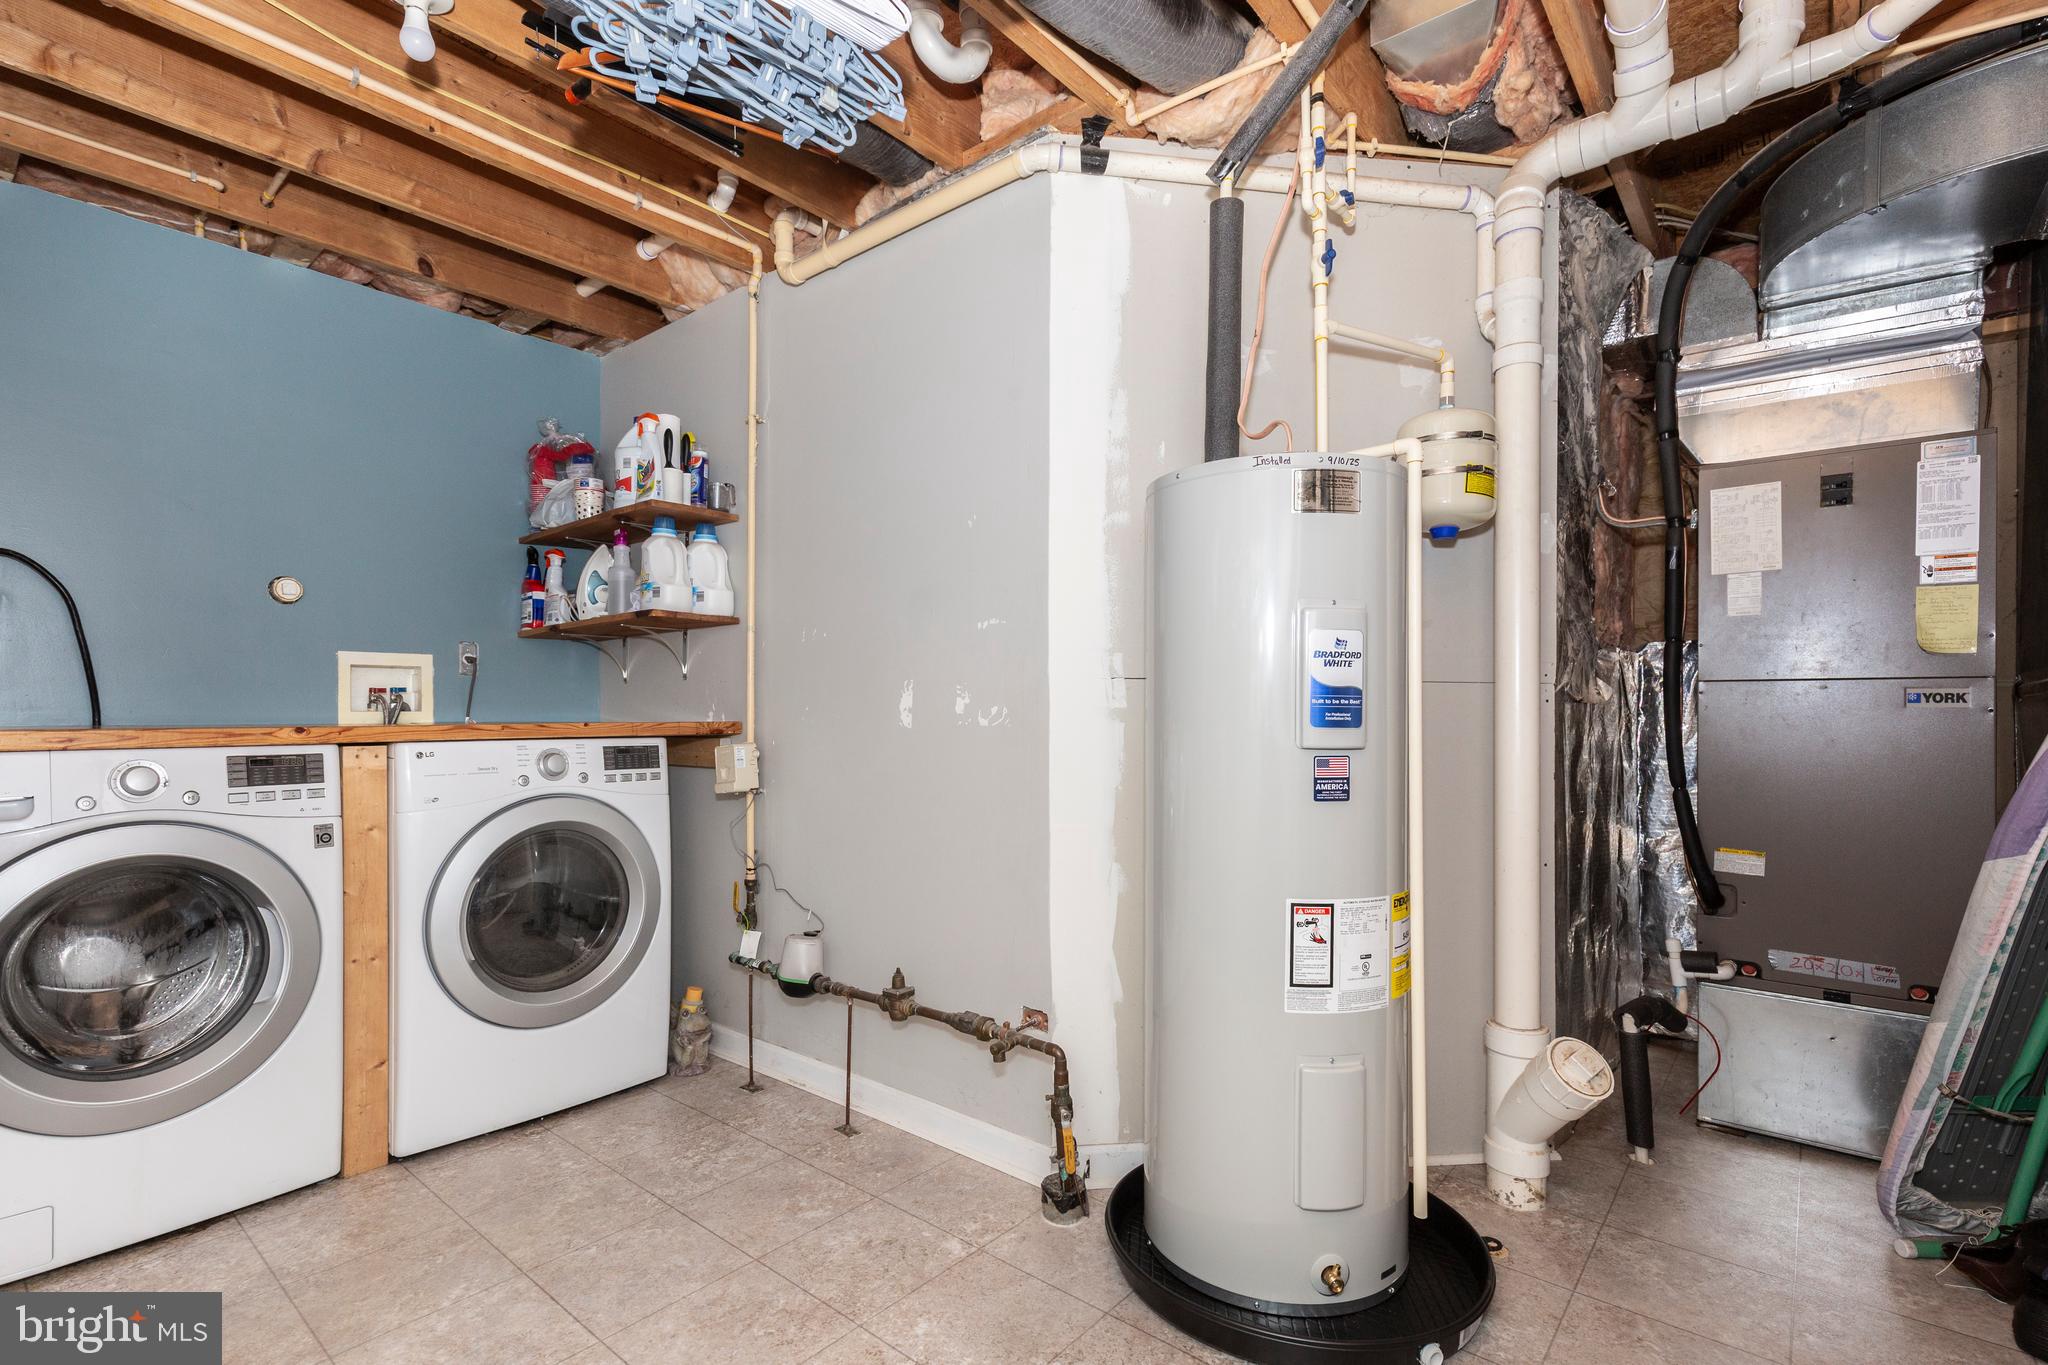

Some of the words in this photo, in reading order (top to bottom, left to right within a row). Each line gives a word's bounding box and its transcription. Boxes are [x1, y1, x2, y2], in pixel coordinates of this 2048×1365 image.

[1252, 455, 1291, 467] Installed
[1327, 456, 1360, 467] 9/10/25
[1313, 650, 1362, 659] BRADFORD
[1323, 659, 1353, 667] WHITE
[1921, 692, 1968, 704] YORK
[1315, 783, 1349, 791] AMERICA
